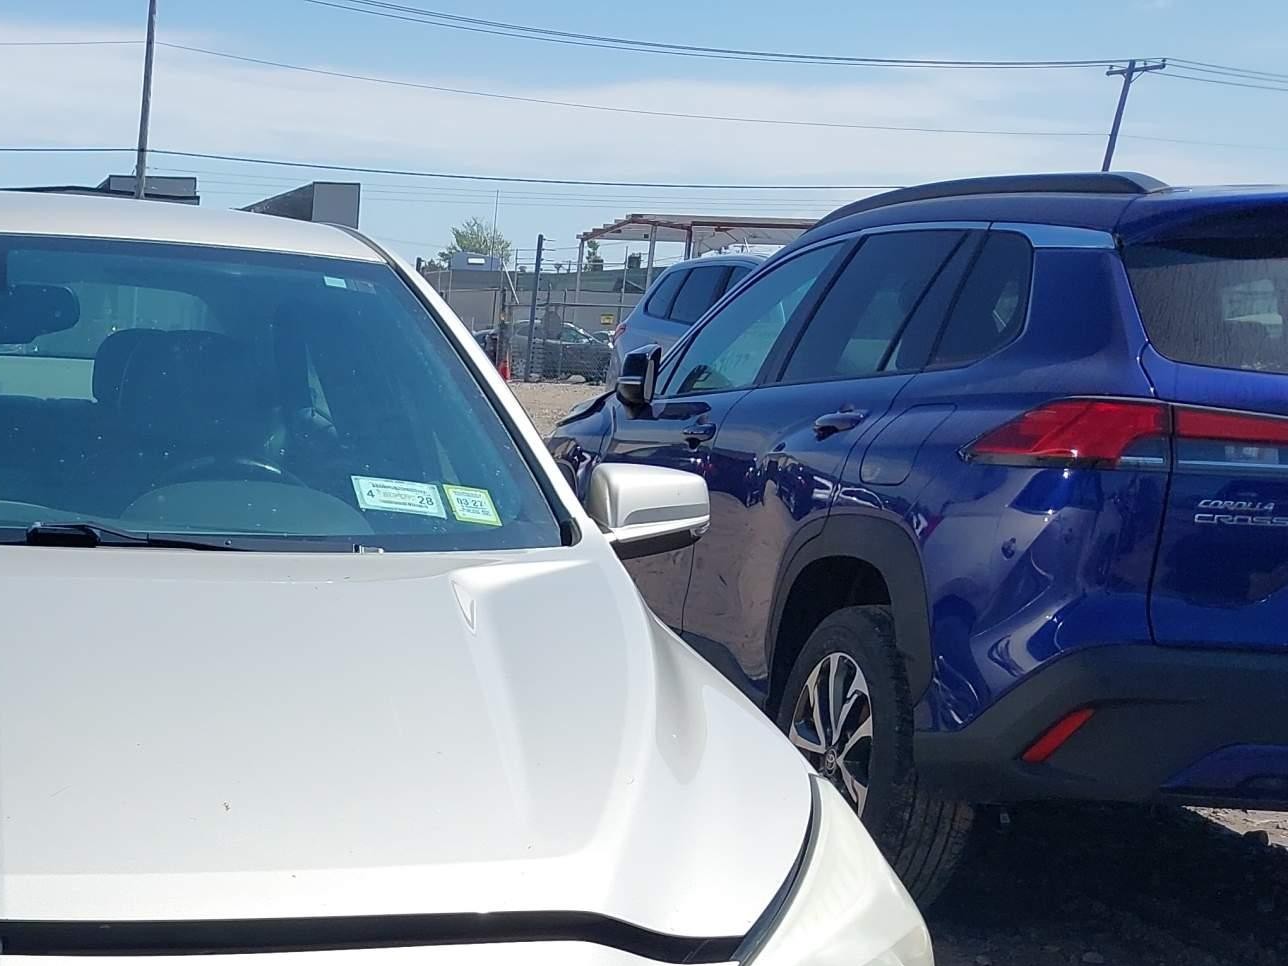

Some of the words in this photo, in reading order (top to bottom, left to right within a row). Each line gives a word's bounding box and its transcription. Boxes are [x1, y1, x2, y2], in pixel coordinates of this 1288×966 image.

[366, 489, 375, 498] 4
[417, 496, 434, 506] 28
[1198, 499, 1275, 511] COROLLA
[1194, 513, 1288, 526] CROSS
